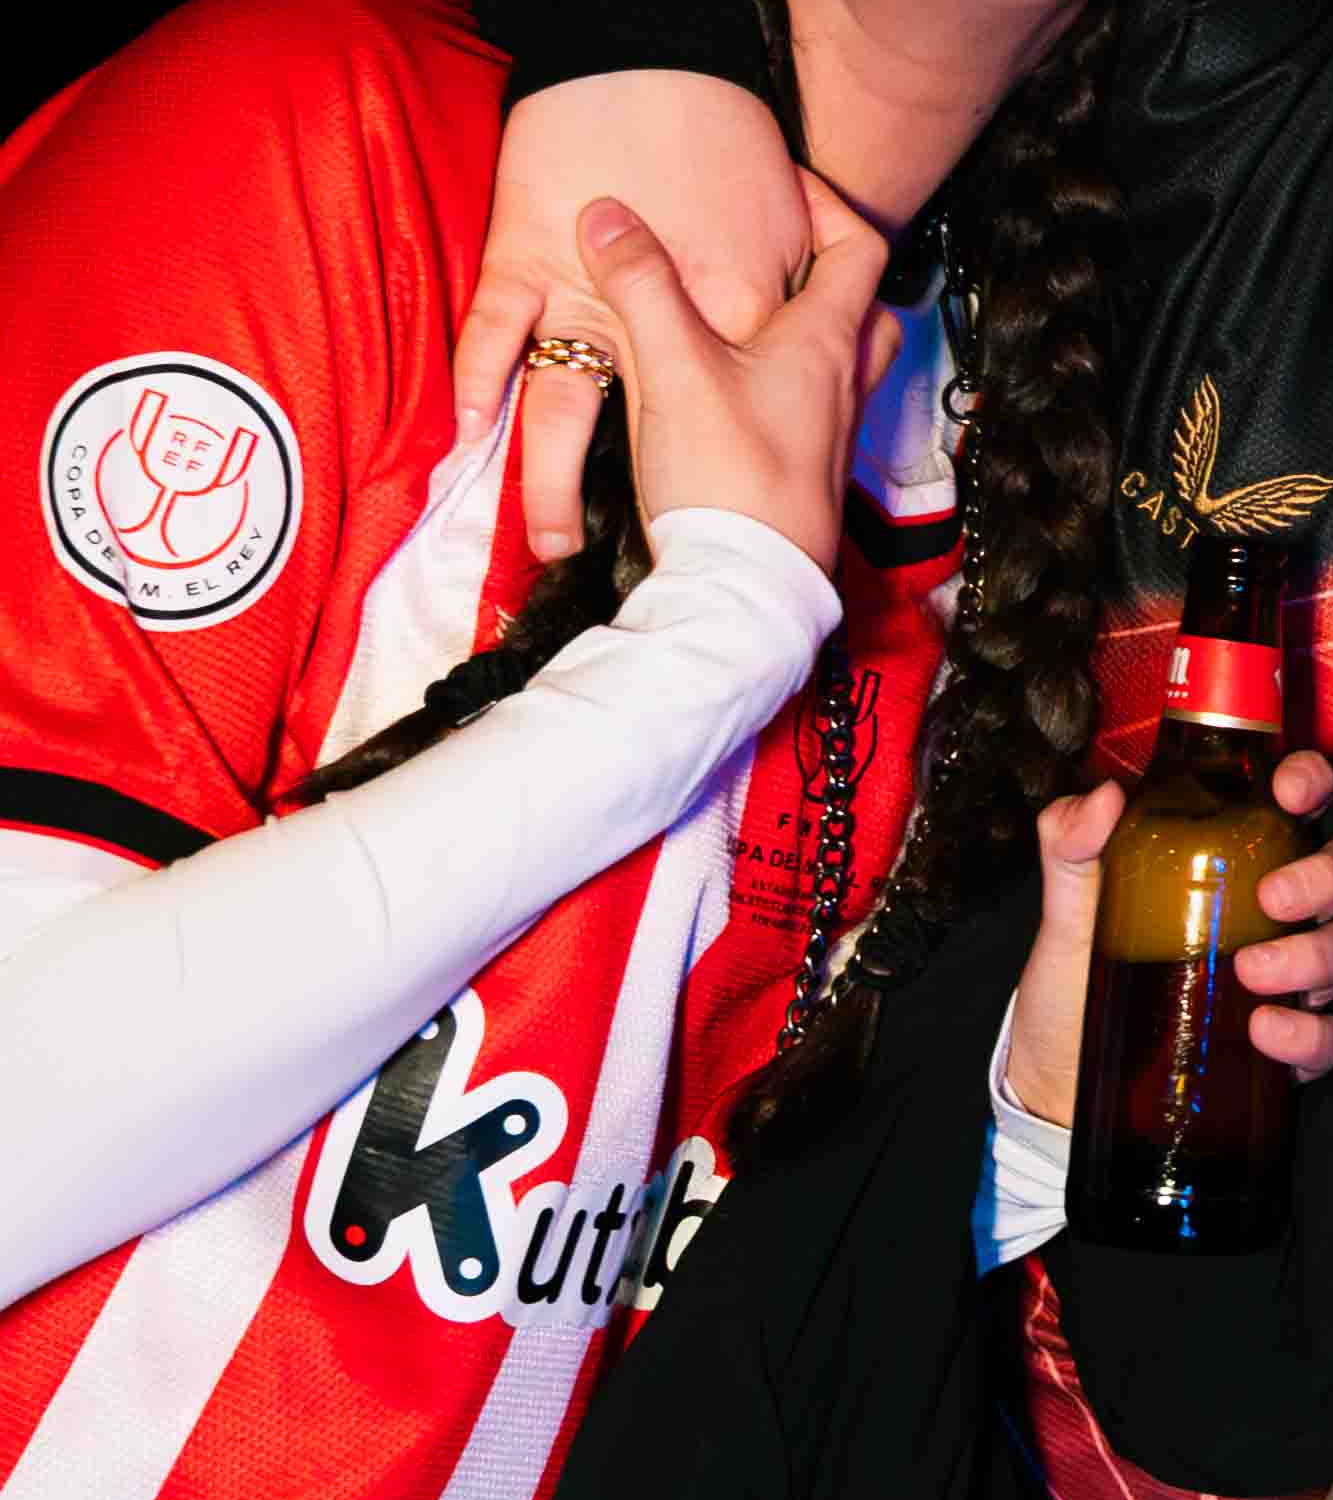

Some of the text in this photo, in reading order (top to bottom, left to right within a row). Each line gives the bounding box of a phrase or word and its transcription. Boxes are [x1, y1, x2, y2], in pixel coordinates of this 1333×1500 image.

[66, 444, 88, 521] COPA
[185, 577, 222, 597] EL
[226, 527, 264, 576] REY
[1120, 471, 1200, 550] CAST
